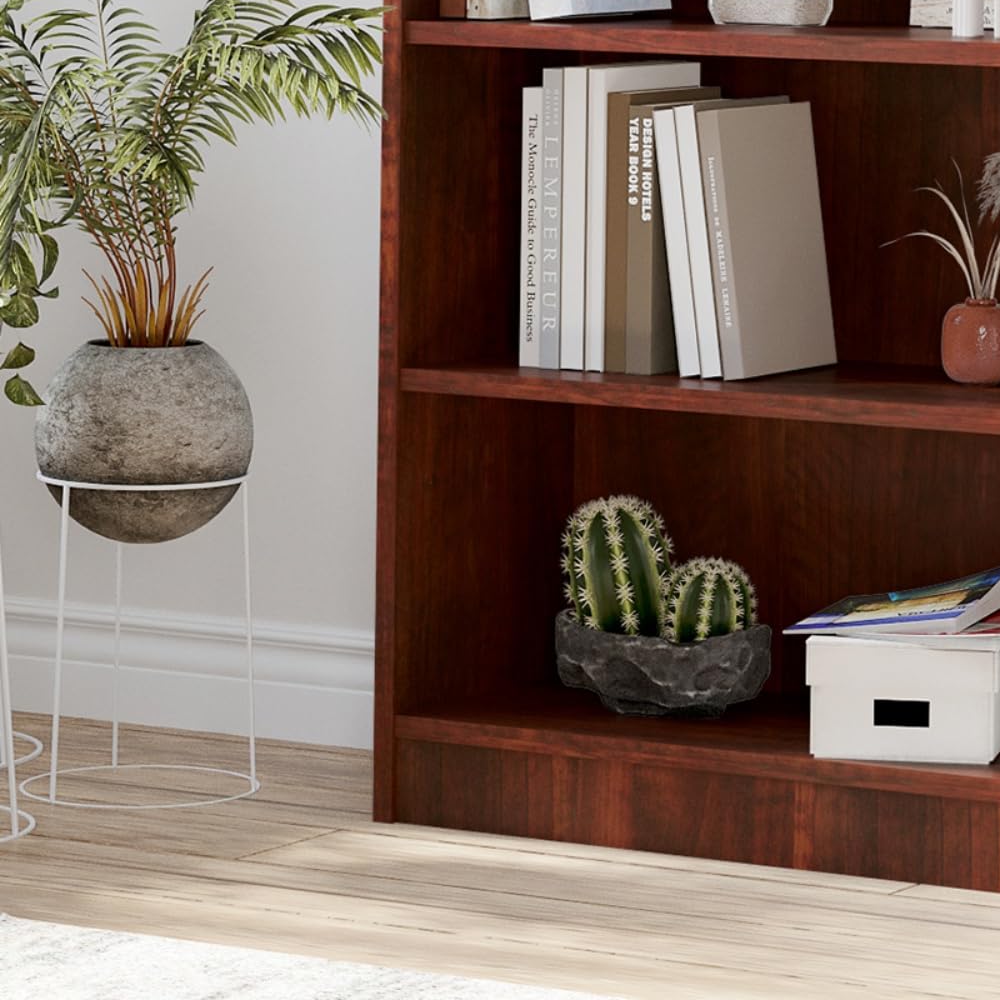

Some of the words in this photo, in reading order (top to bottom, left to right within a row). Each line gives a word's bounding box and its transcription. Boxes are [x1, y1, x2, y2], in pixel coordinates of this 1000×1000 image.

[528, 115, 537, 138] The
[627, 117, 640, 152] YEAR
[640, 117, 654, 168] DESIGN
[526, 142, 537, 194] Monocle
[626, 155, 640, 192] BOOK
[628, 196, 638, 205] 9
[639, 171, 655, 221] HOTELS
[526, 198, 536, 234] Guide
[543, 136, 558, 330] LEMPEREUR
[526, 239, 535, 250] to
[526, 253, 535, 286] Good
[524, 291, 535, 342] Business
